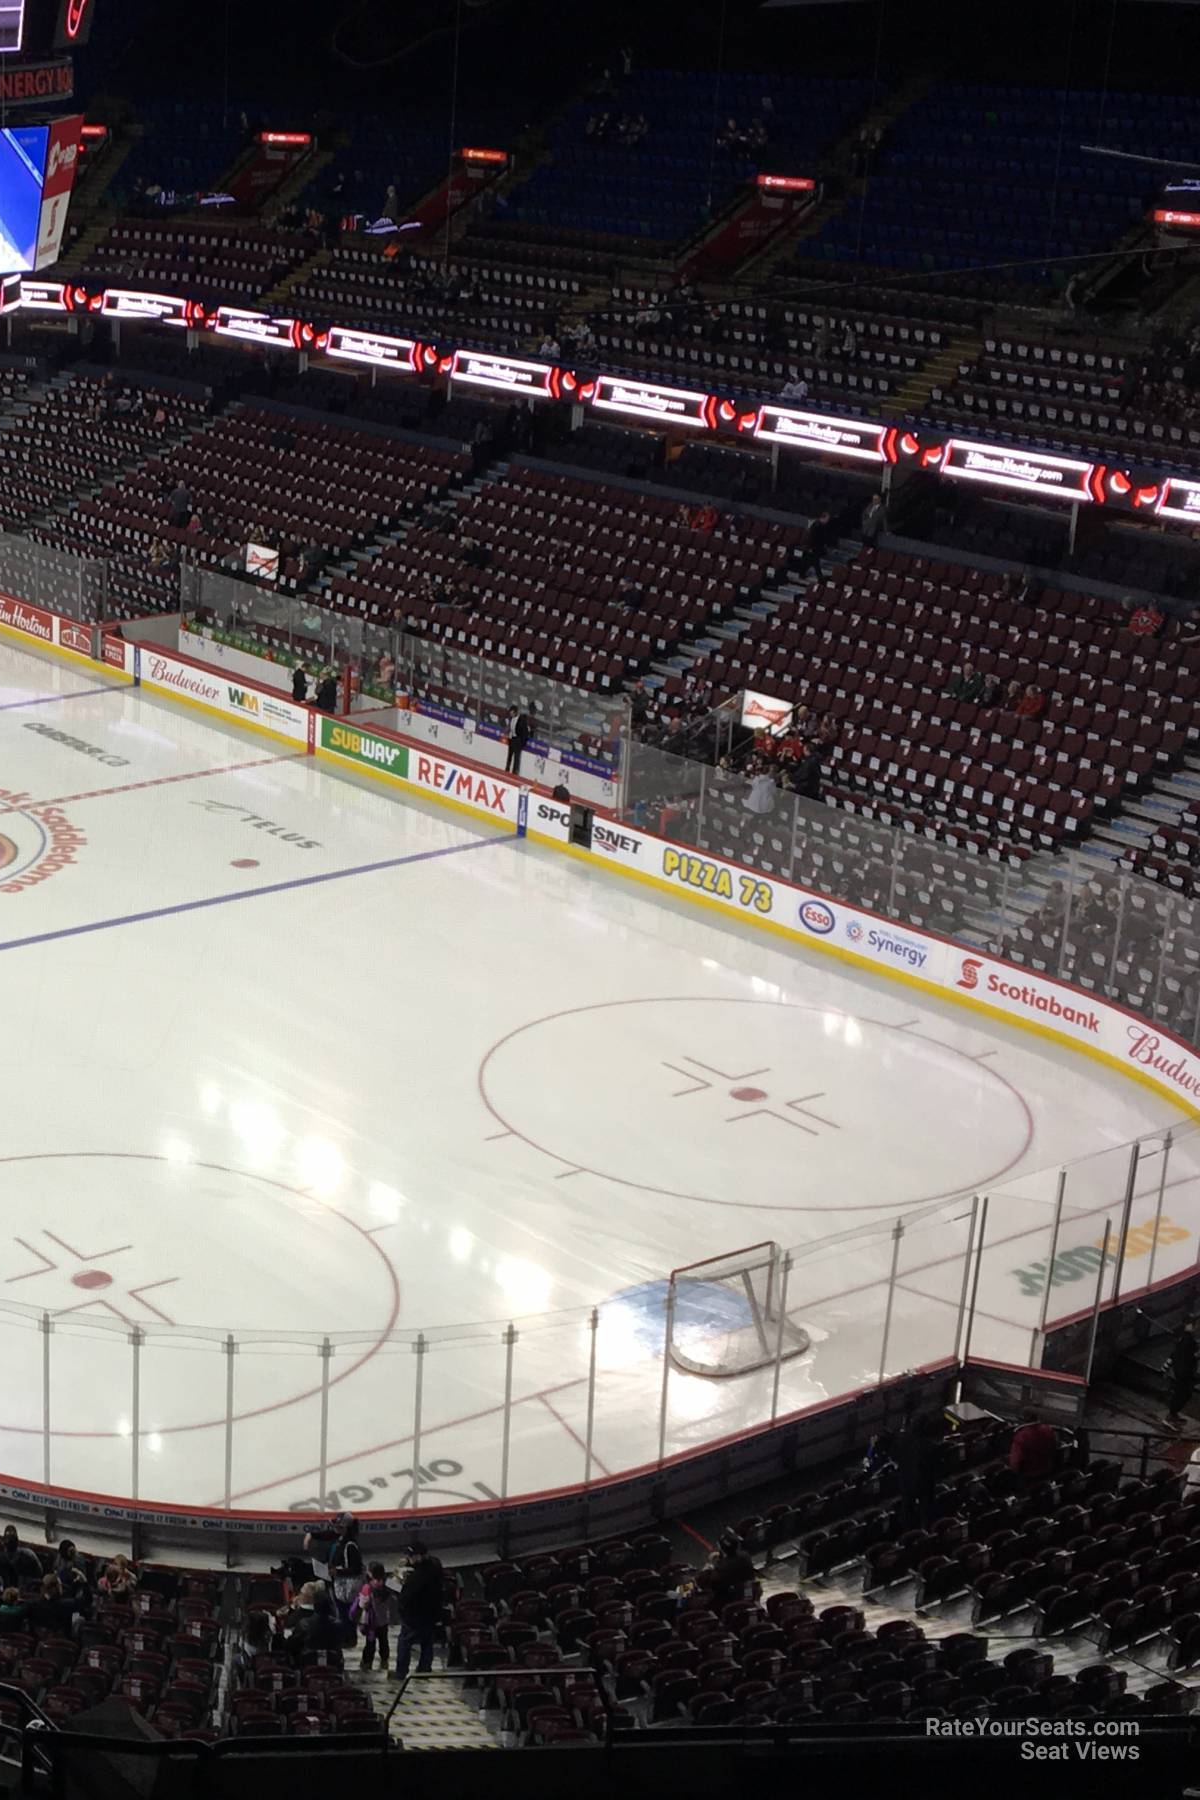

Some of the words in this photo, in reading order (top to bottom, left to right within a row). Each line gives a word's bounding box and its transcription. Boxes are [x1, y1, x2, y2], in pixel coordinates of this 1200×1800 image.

[12, 603, 51, 639] Hortons
[148, 655, 220, 700] Budweiser
[228, 687, 260, 713] WM
[330, 726, 400, 766] SUBWAY
[417, 756, 516, 813] RE/MAX
[240, 814, 323, 849] TELUS
[537, 804, 642, 855] SPOSNET
[663, 846, 732, 899] PIZZA
[738, 875, 773, 913] 73
[868, 930, 928, 967] Synergy
[987, 974, 1101, 1033] Scotiabank
[368, 1476, 389, 1488] &
[390, 1458, 464, 1486] OIL
